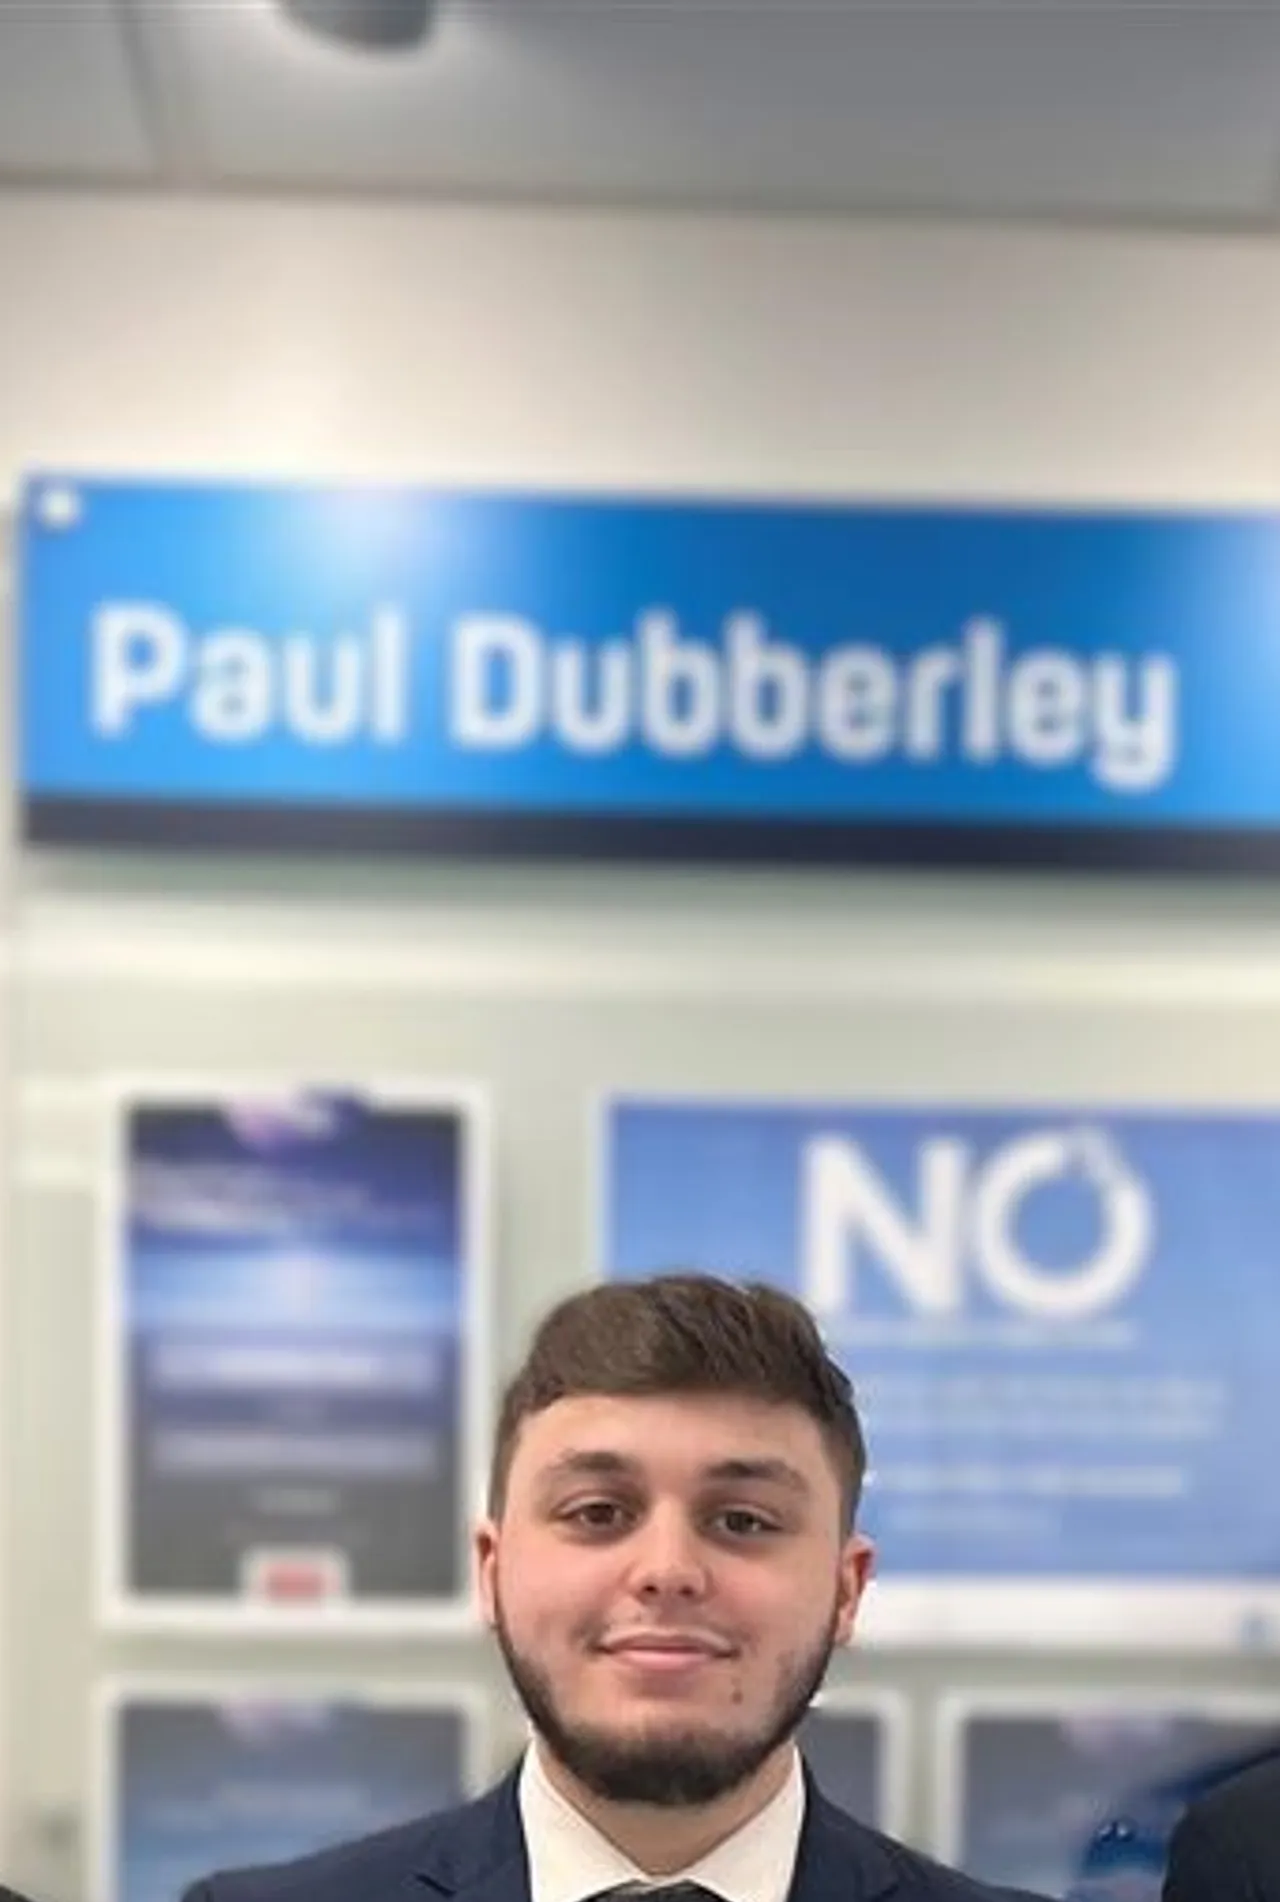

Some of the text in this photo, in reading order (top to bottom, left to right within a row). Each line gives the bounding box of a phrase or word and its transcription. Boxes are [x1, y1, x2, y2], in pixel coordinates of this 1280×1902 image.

[92, 600, 1177, 792] Paul Dubberley
[803, 1130, 1153, 1318] NO
